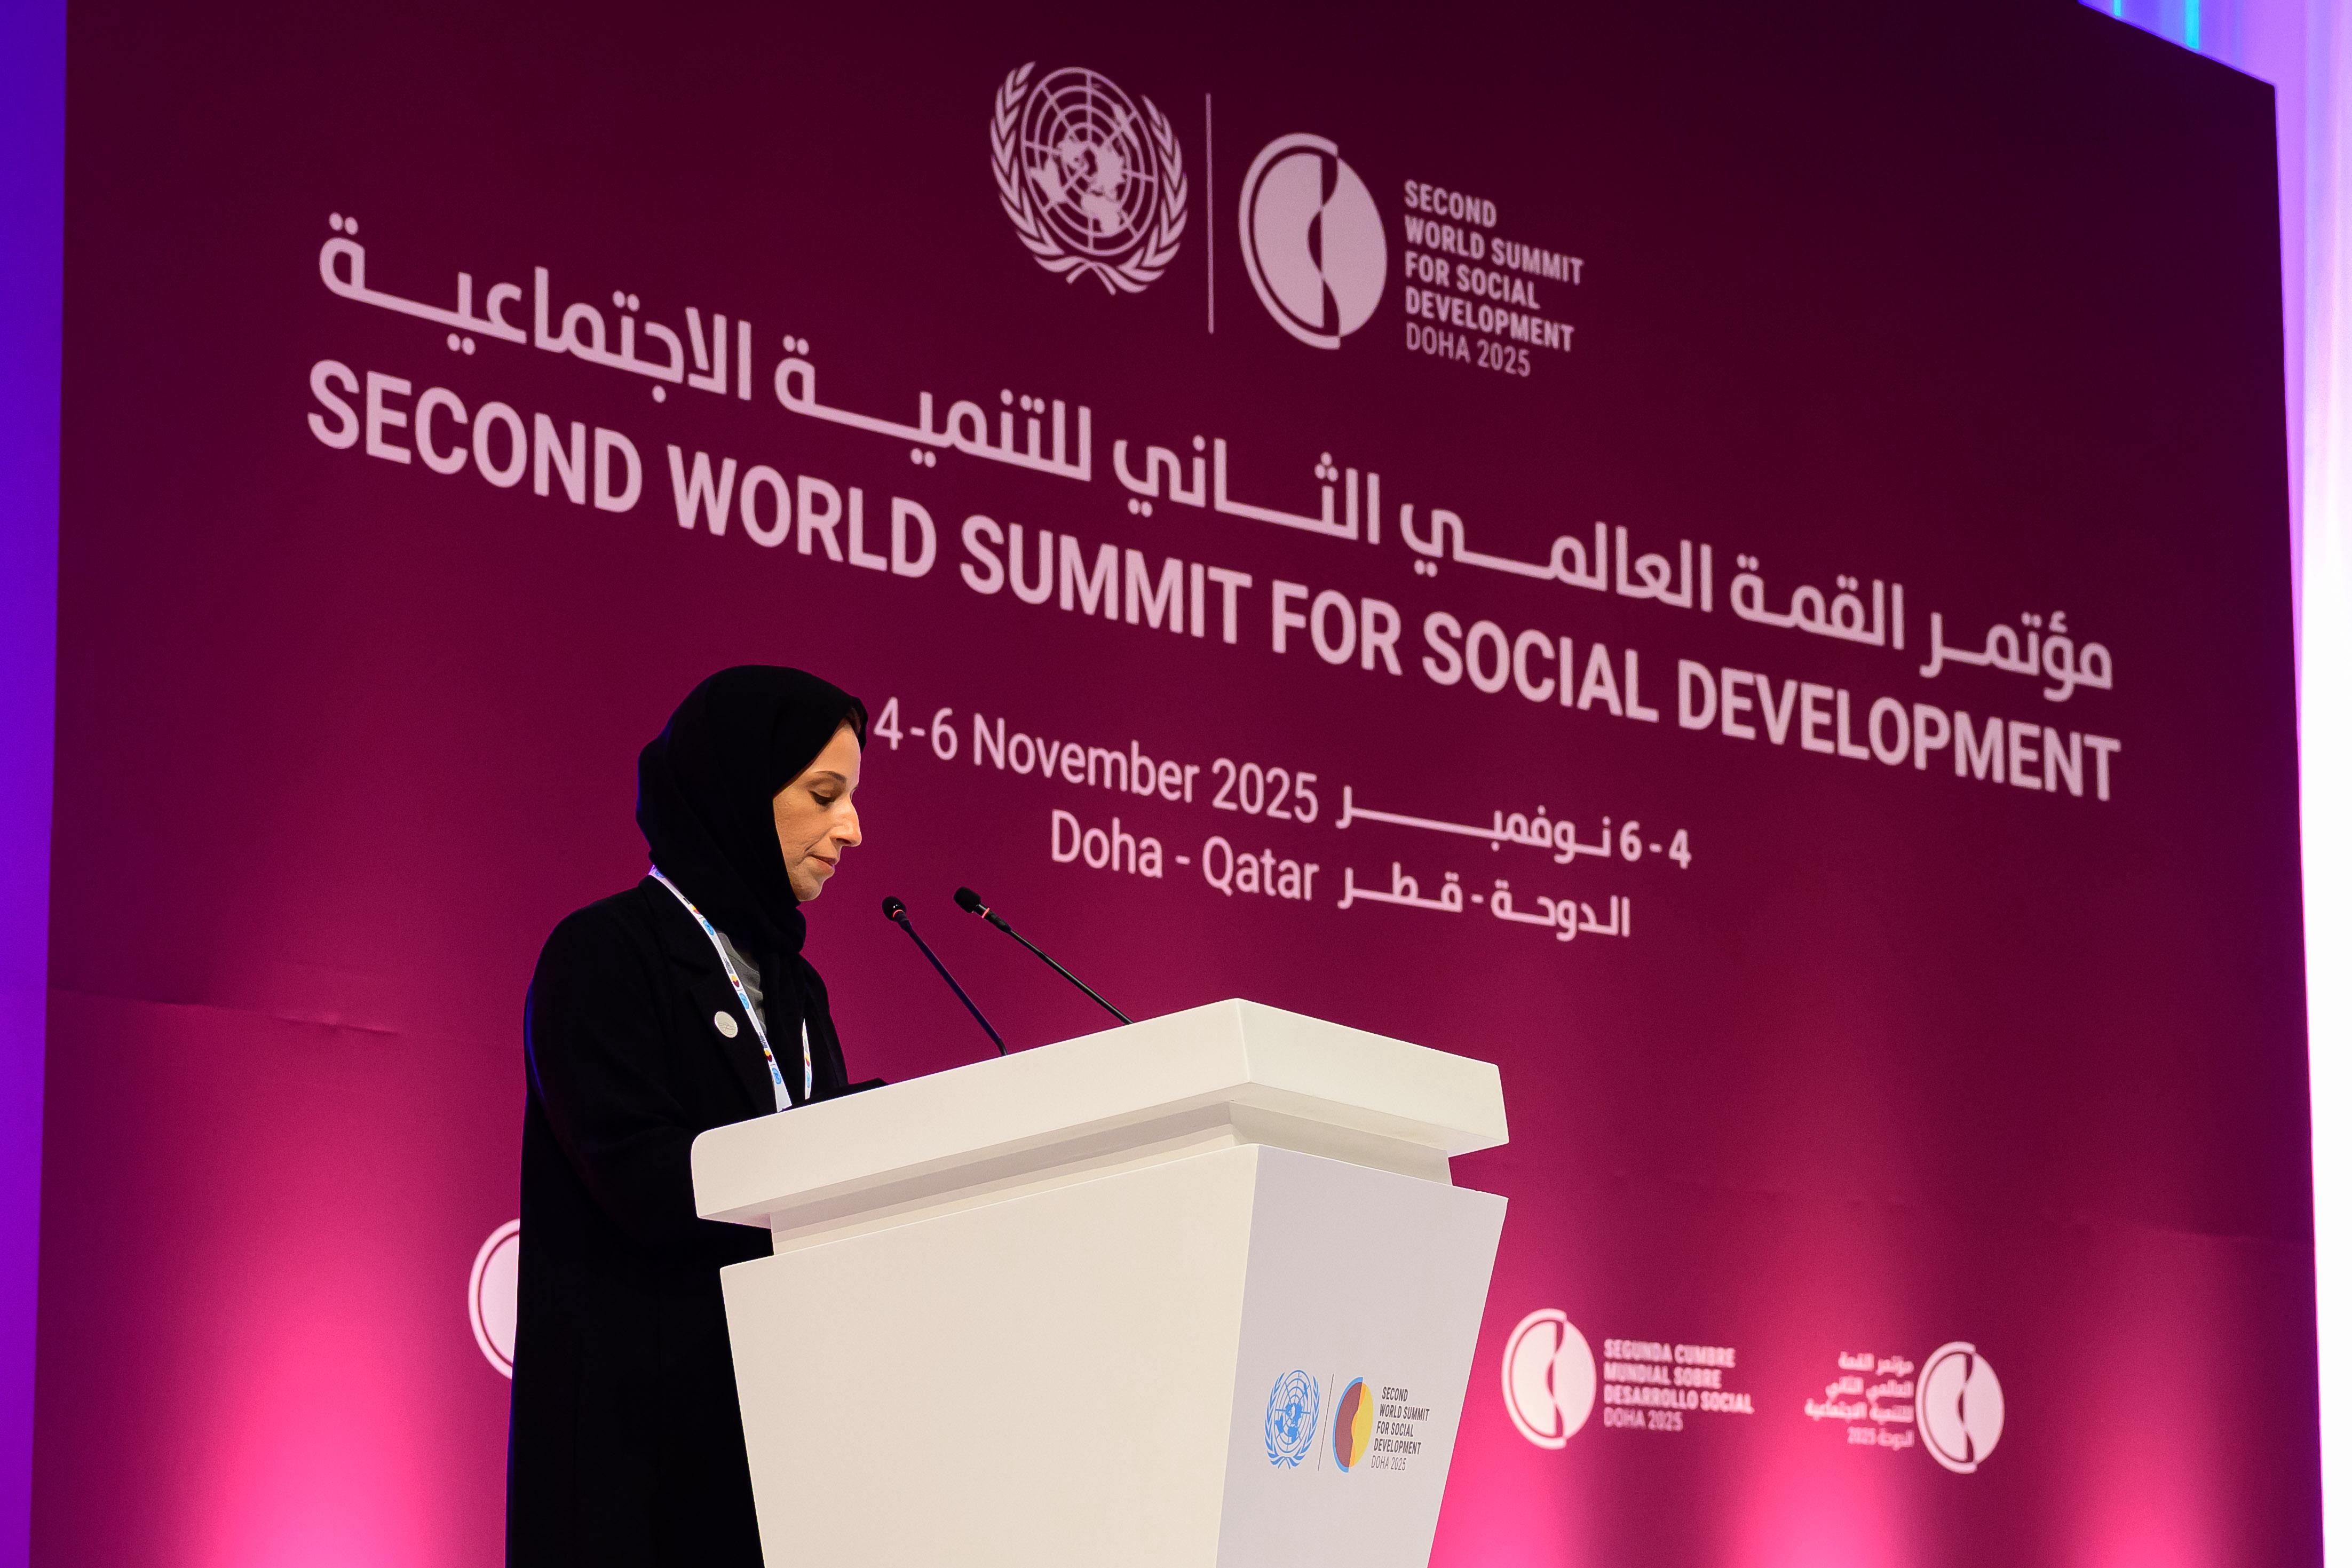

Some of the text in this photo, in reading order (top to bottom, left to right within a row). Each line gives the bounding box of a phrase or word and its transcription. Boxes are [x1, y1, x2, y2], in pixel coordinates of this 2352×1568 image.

[1405, 180, 1496, 227] SECOND
[1405, 215, 1583, 284] WORLD SUMMIT
[1405, 251, 1540, 309] FOR SOCIAL
[1406, 286, 1573, 351] DEVELOPMENT
[1407, 322, 1530, 376] DOHA 2025
[319, 213, 2112, 702] مؤتمر القمة العالمي الثاني للتنمية الاجتماعية
[307, 360, 2121, 801] SECOND WORLD SUMMIT FOR SOCIAL DEVELOPMENT
[973, 713, 1200, 803] November
[1211, 757, 1318, 823] 2025
[1335, 785, 1611, 865] نوفمبر
[1051, 809, 1163, 878] Doha
[1202, 836, 1320, 901] Qatar
[1337, 861, 1463, 913] قطر
[1490, 879, 1630, 942] الدوحة
[1604, 1339, 1736, 1368] SEGUNDA CUMBRE
[1604, 1361, 1722, 1389] MUNDIAL SOBRE
[1379, 1404, 1430, 1421] WORLD SUMMIT
[1382, 1386, 1408, 1402] SECOND
[1604, 1384, 1755, 1414] DESARROLLO SOCIAL
[1604, 1407, 1684, 1431] DOHA 2025
[1373, 1438, 1422, 1455] DEVELOPMENT
[1376, 1421, 1414, 1437] FOR SOCIAL
[1371, 1455, 1407, 1471] DOHA 2025
